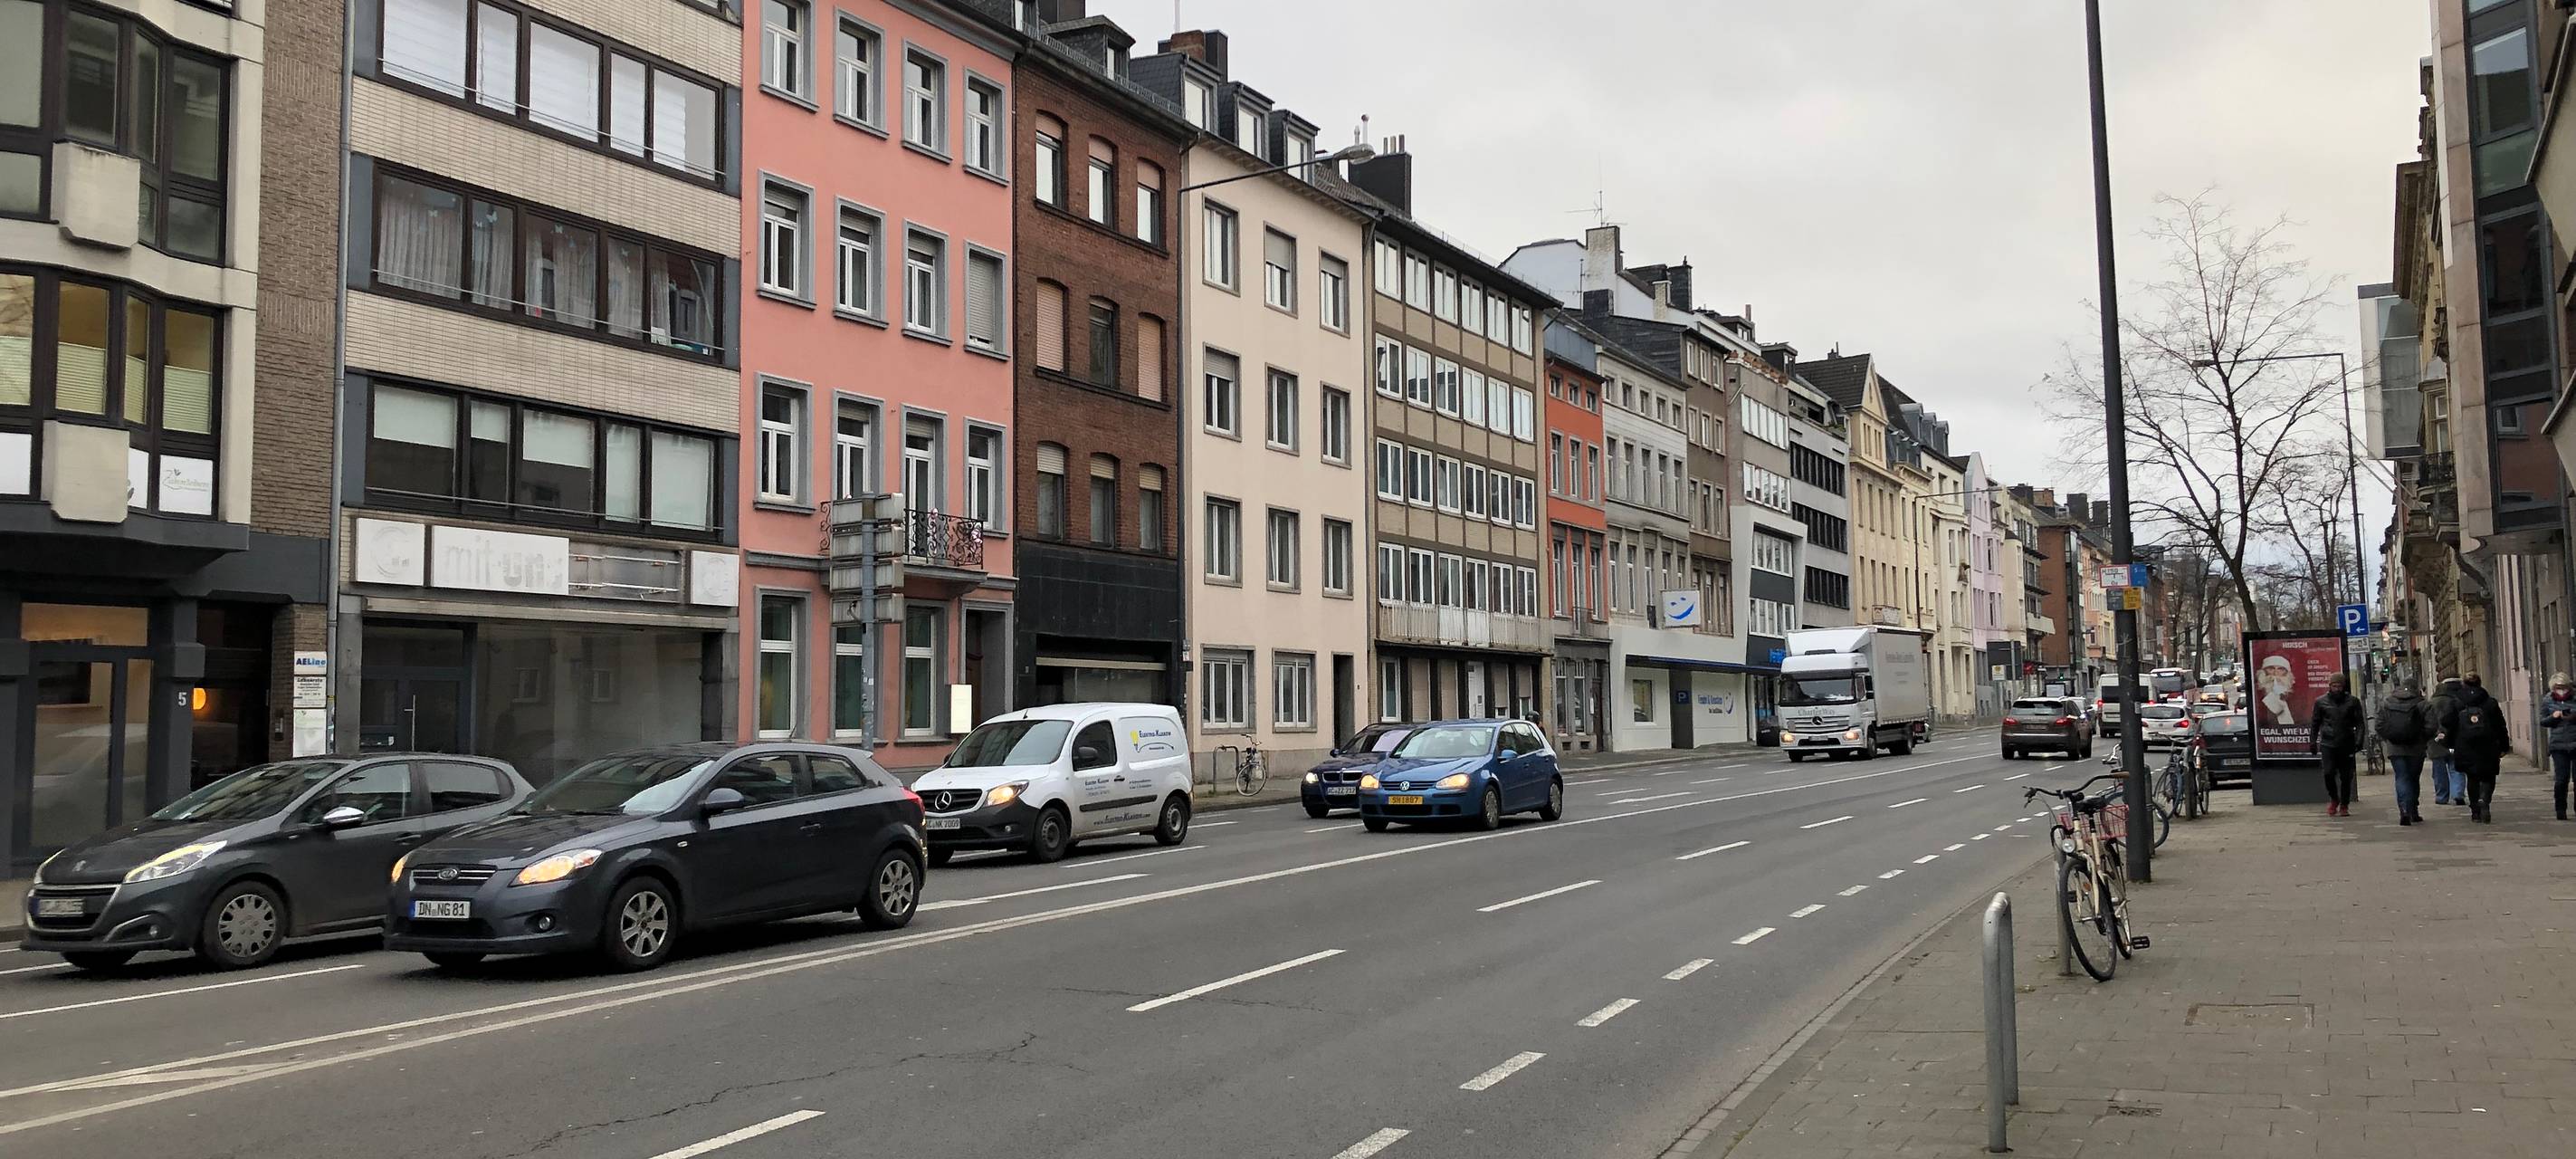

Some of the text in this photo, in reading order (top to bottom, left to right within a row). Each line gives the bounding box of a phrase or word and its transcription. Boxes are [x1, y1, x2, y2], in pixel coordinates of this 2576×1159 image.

[2344, 608, 2361, 634] P
[178, 692, 186, 706] 5
[1678, 692, 1687, 703] P
[418, 902, 465, 916] DN NG 81
